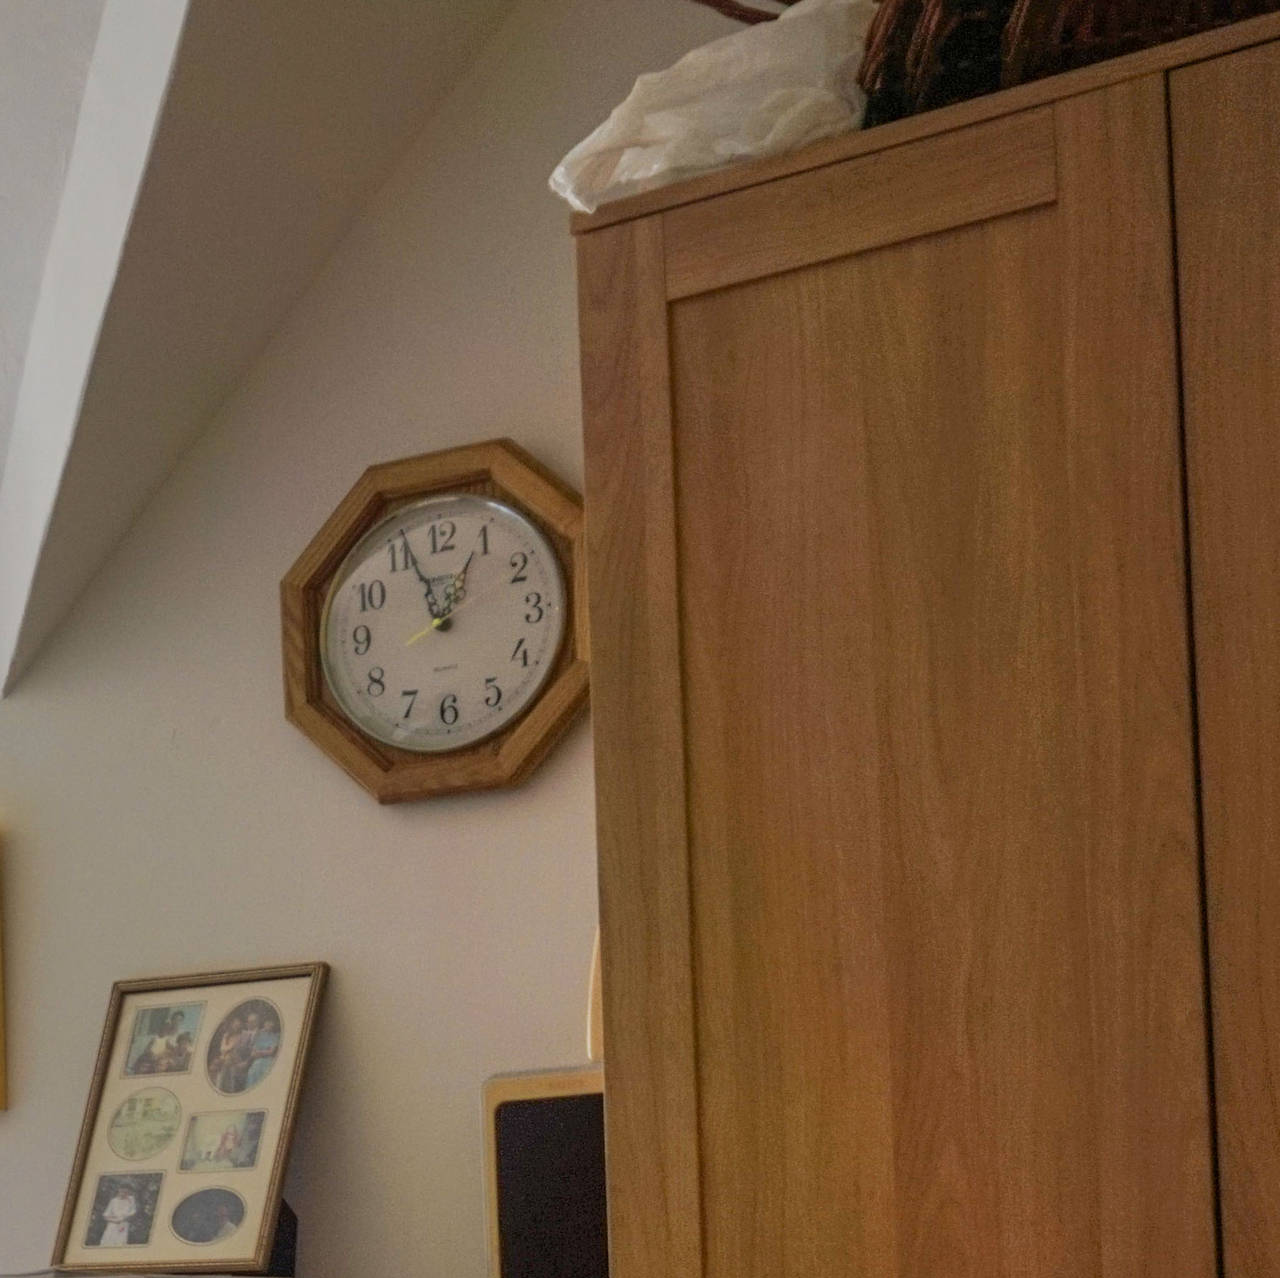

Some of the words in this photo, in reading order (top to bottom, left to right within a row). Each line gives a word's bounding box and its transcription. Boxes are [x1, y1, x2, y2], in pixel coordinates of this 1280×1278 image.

[427, 521, 457, 553] 12
[477, 525, 490, 556] 1
[388, 538, 415, 573] 11
[509, 551, 528, 584] 2
[358, 579, 387, 612] 10
[524, 592, 544, 624] 3
[352, 624, 372, 656] 9
[510, 638, 529, 668] 4
[366, 666, 386, 697] 8
[483, 676, 502, 708] 5
[400, 689, 419, 719] 7
[439, 694, 459, 725] 6
